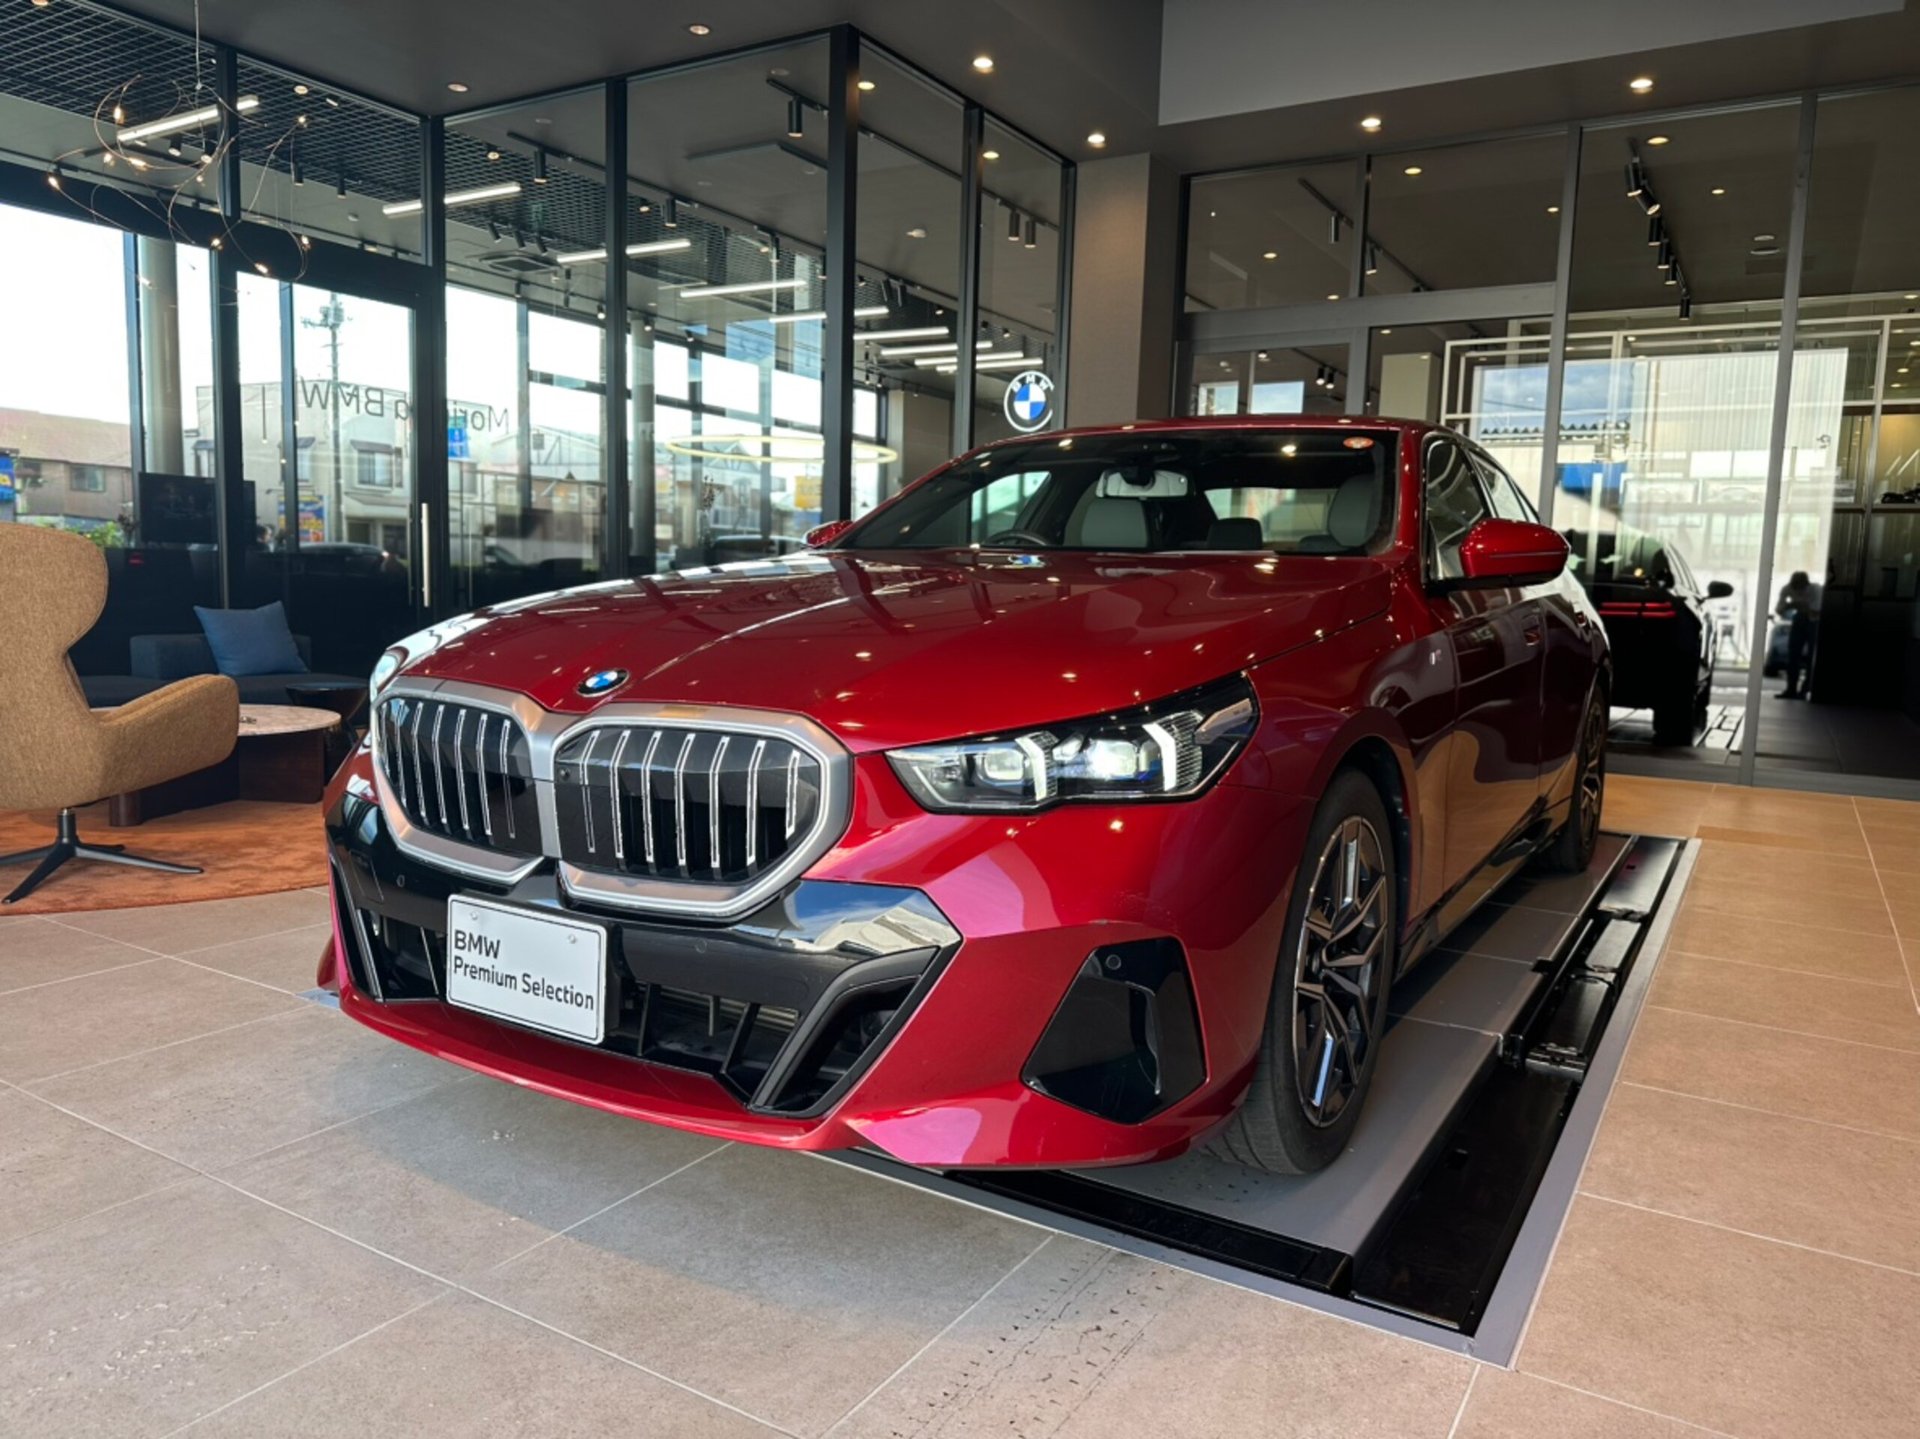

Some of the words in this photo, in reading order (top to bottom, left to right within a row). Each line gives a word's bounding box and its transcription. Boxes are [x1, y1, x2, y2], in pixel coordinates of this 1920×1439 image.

[454, 930, 501, 959] BMW
[453, 956, 518, 991] Premium
[521, 973, 595, 1010] Selection
